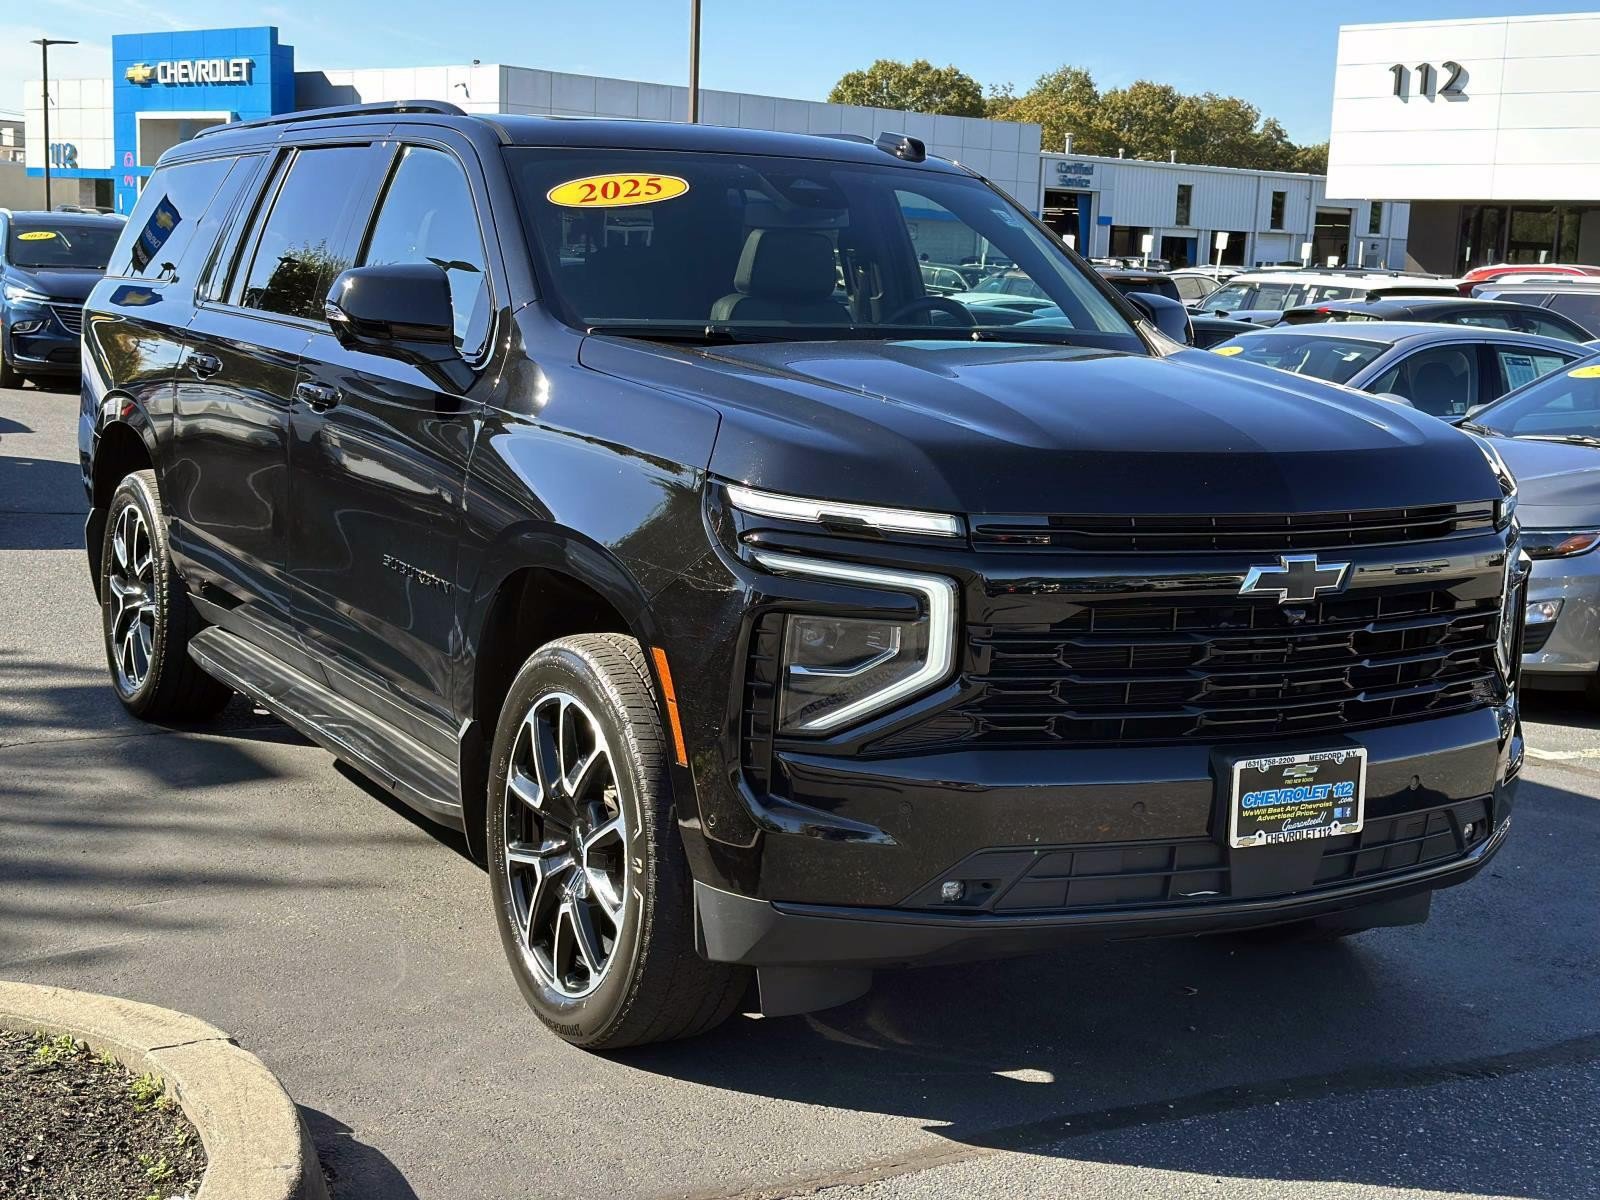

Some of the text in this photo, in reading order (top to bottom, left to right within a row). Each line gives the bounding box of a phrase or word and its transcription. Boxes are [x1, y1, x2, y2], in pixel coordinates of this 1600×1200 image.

[157, 58, 251, 84] CHEVROLET
[1387, 60, 1468, 103] 112
[50, 143, 77, 167] 112
[1057, 161, 1094, 175] Certified
[1058, 174, 1091, 188] Service
[578, 177, 662, 203] 2025
[1264, 756, 1295, 766] 758-2200
[1242, 781, 1354, 808] CHEVROLET 112
[1337, 796, 1354, 804] .com
[1254, 808, 1267, 816] Will
[1268, 806, 1284, 814] Beat
[1300, 801, 1333, 810] Chevrolet
[1256, 811, 1295, 822] Advertised
[1266, 826, 1332, 844] CHEVROLET 112
